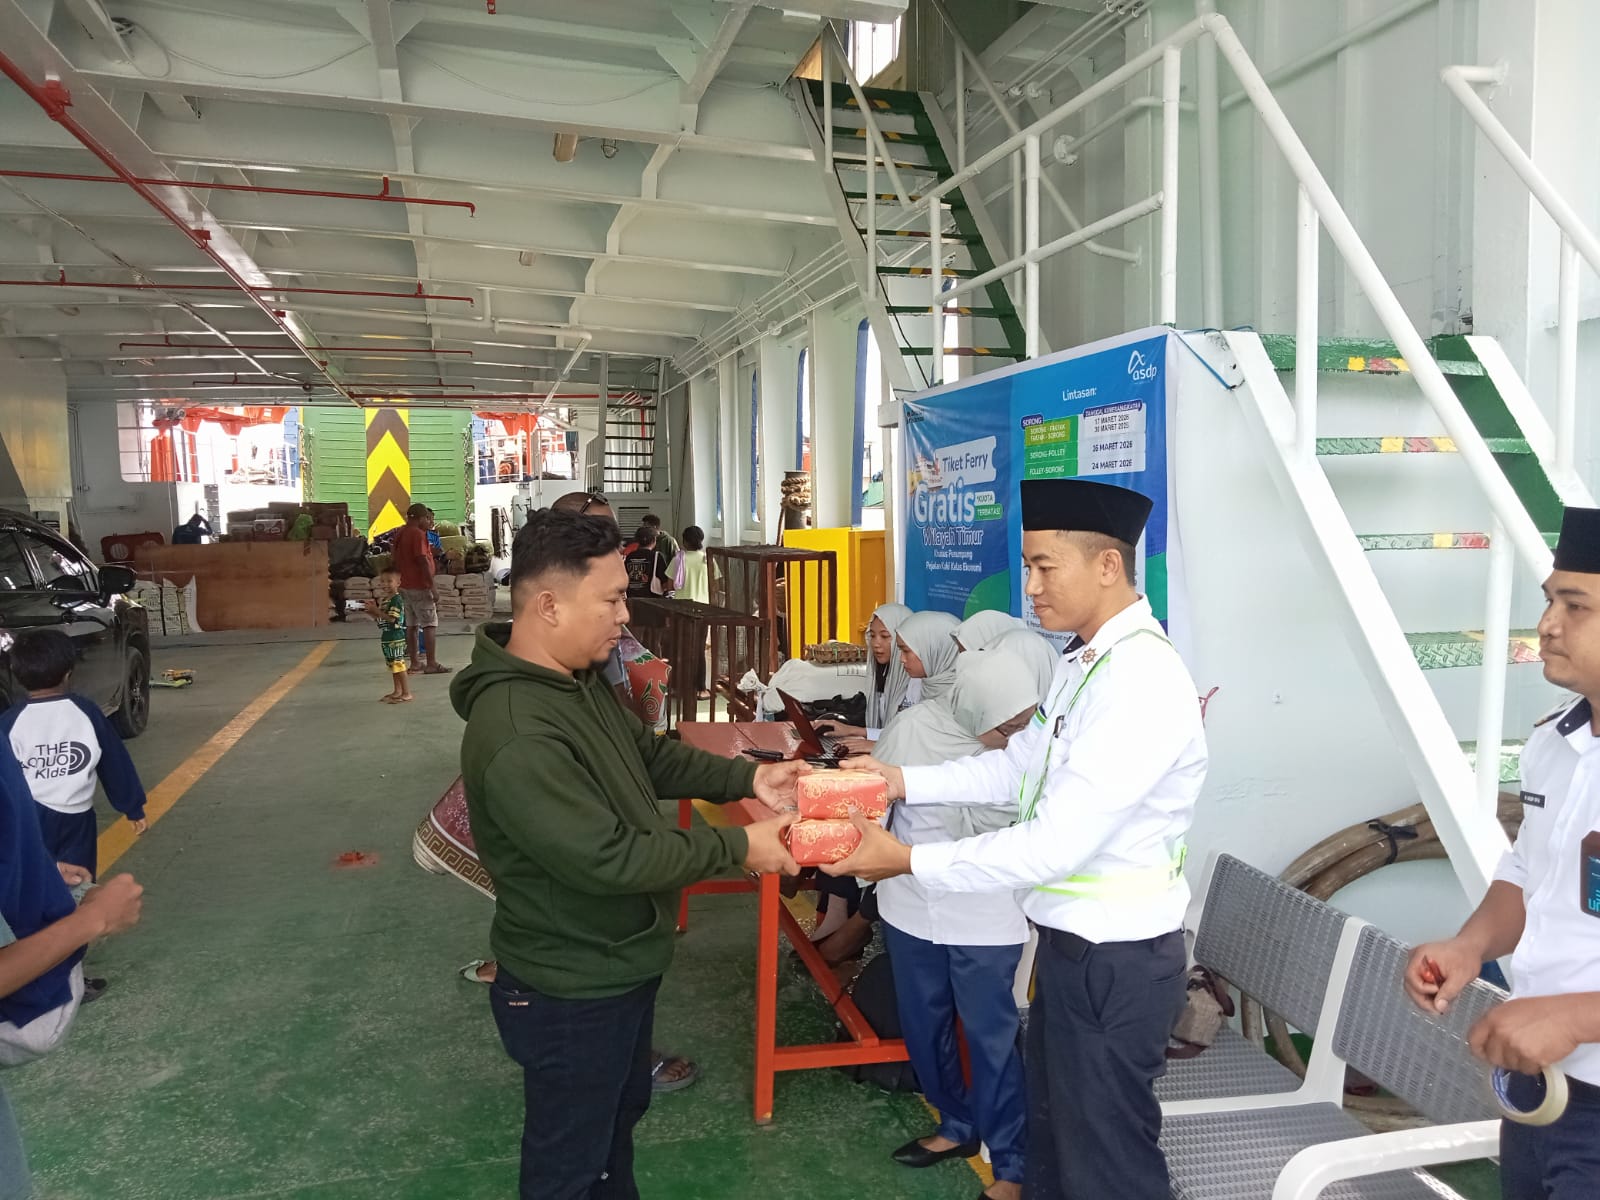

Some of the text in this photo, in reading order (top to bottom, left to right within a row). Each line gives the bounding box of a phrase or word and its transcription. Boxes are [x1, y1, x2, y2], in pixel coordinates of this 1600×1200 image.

[1132, 364, 1156, 380] asdp
[1062, 387, 1097, 401] Lintasan:
[1022, 417, 1042, 426] SORONG
[1101, 416, 1117, 424] MARET
[1101, 424, 1117, 432] MARET
[1100, 442, 1118, 451] MARET
[942, 452, 988, 473] Tiket Ferry
[1100, 460, 1118, 469] MARET
[1120, 459, 1132, 467] 2026
[914, 478, 974, 522] Gratis
[923, 527, 984, 549] Wilayah Timur
[35, 742, 68, 756] THE
